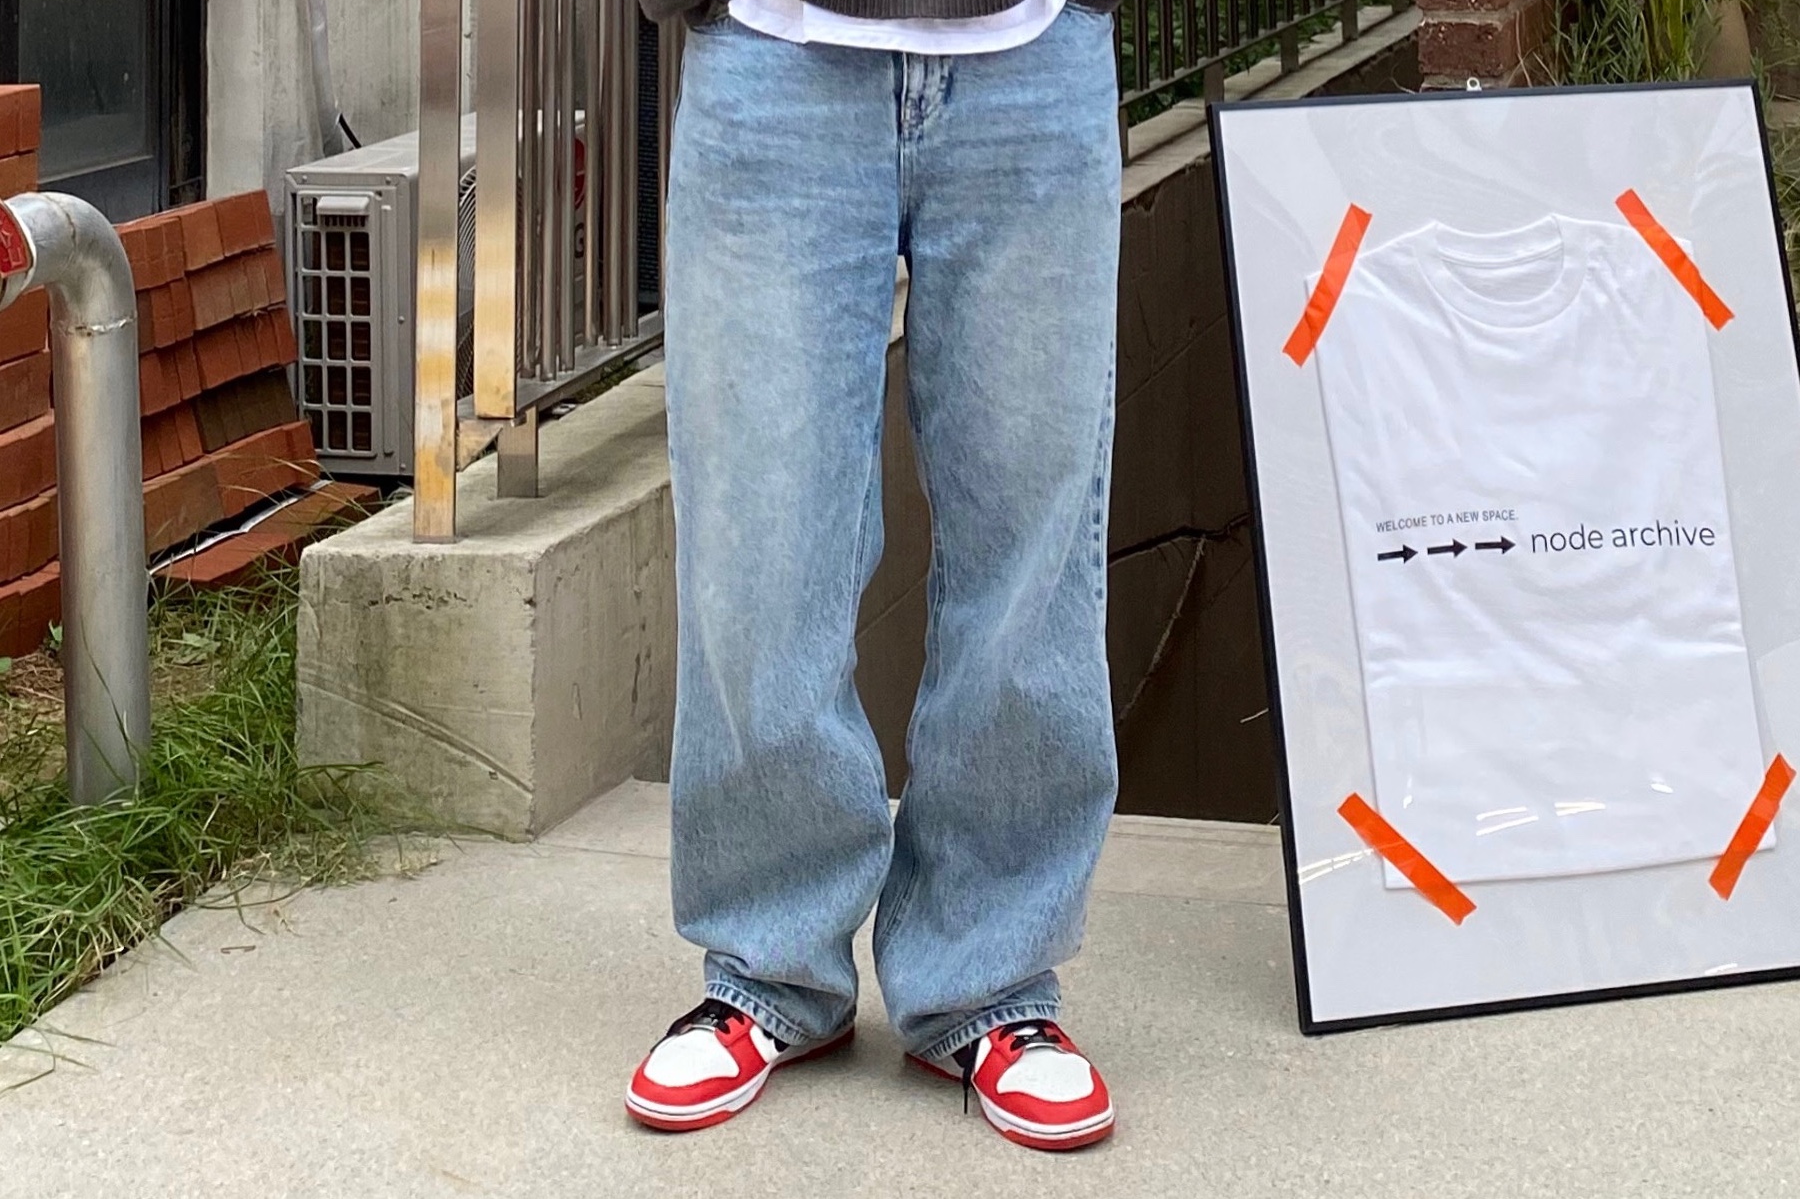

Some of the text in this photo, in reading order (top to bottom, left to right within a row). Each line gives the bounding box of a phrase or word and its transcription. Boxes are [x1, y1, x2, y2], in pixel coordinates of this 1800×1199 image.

[1376, 509, 1519, 532] WELCOME TO A NEW SPACE.
[1531, 519, 1715, 553] node archive
